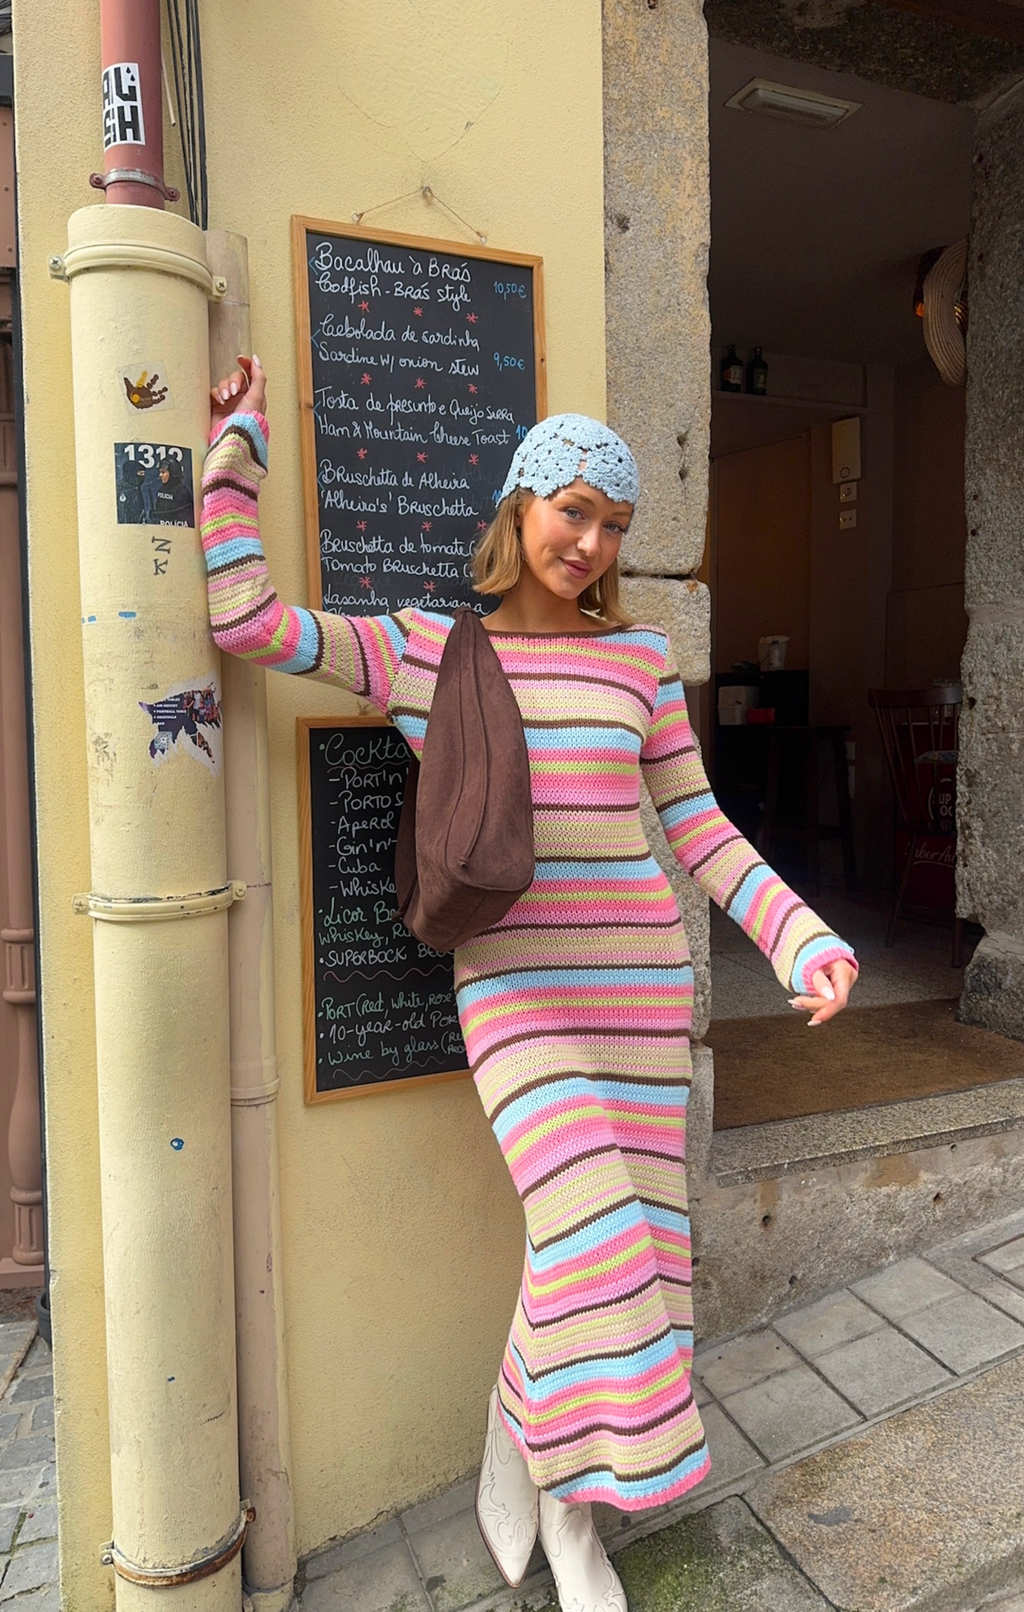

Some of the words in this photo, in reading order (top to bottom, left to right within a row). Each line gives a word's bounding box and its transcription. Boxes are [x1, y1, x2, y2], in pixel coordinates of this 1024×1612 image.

[314, 242, 405, 274] Bacalhau
[315, 271, 381, 304] Codfish
[437, 284, 471, 312] style
[493, 281, 527, 300] 10,50€
[319, 313, 396, 341] Cebolada
[401, 325, 418, 342] de
[318, 341, 378, 365] Sardine
[399, 356, 444, 372] onion
[493, 352, 526, 371] 9,50€
[314, 386, 359, 410] Tosta
[366, 392, 383, 411] de
[438, 404, 447, 415] e
[449, 398, 484, 425] Queijo
[319, 415, 351, 438] Ham
[363, 420, 428, 444] Mountain
[430, 421, 471, 447] Cheese
[472, 429, 511, 445] Toast
[401, 471, 414, 487] de
[419, 471, 470, 491] Alheira
[399, 536, 417, 554] de
[420, 532, 469, 557] tomate
[321, 556, 377, 574] Tomato
[323, 584, 390, 608] Lasanha
[338, 857, 381, 875] Cuba
[323, 897, 368, 927] Licor
[328, 1045, 374, 1065] Wine
[380, 1041, 399, 1066] by
[404, 1038, 440, 1063] glass
